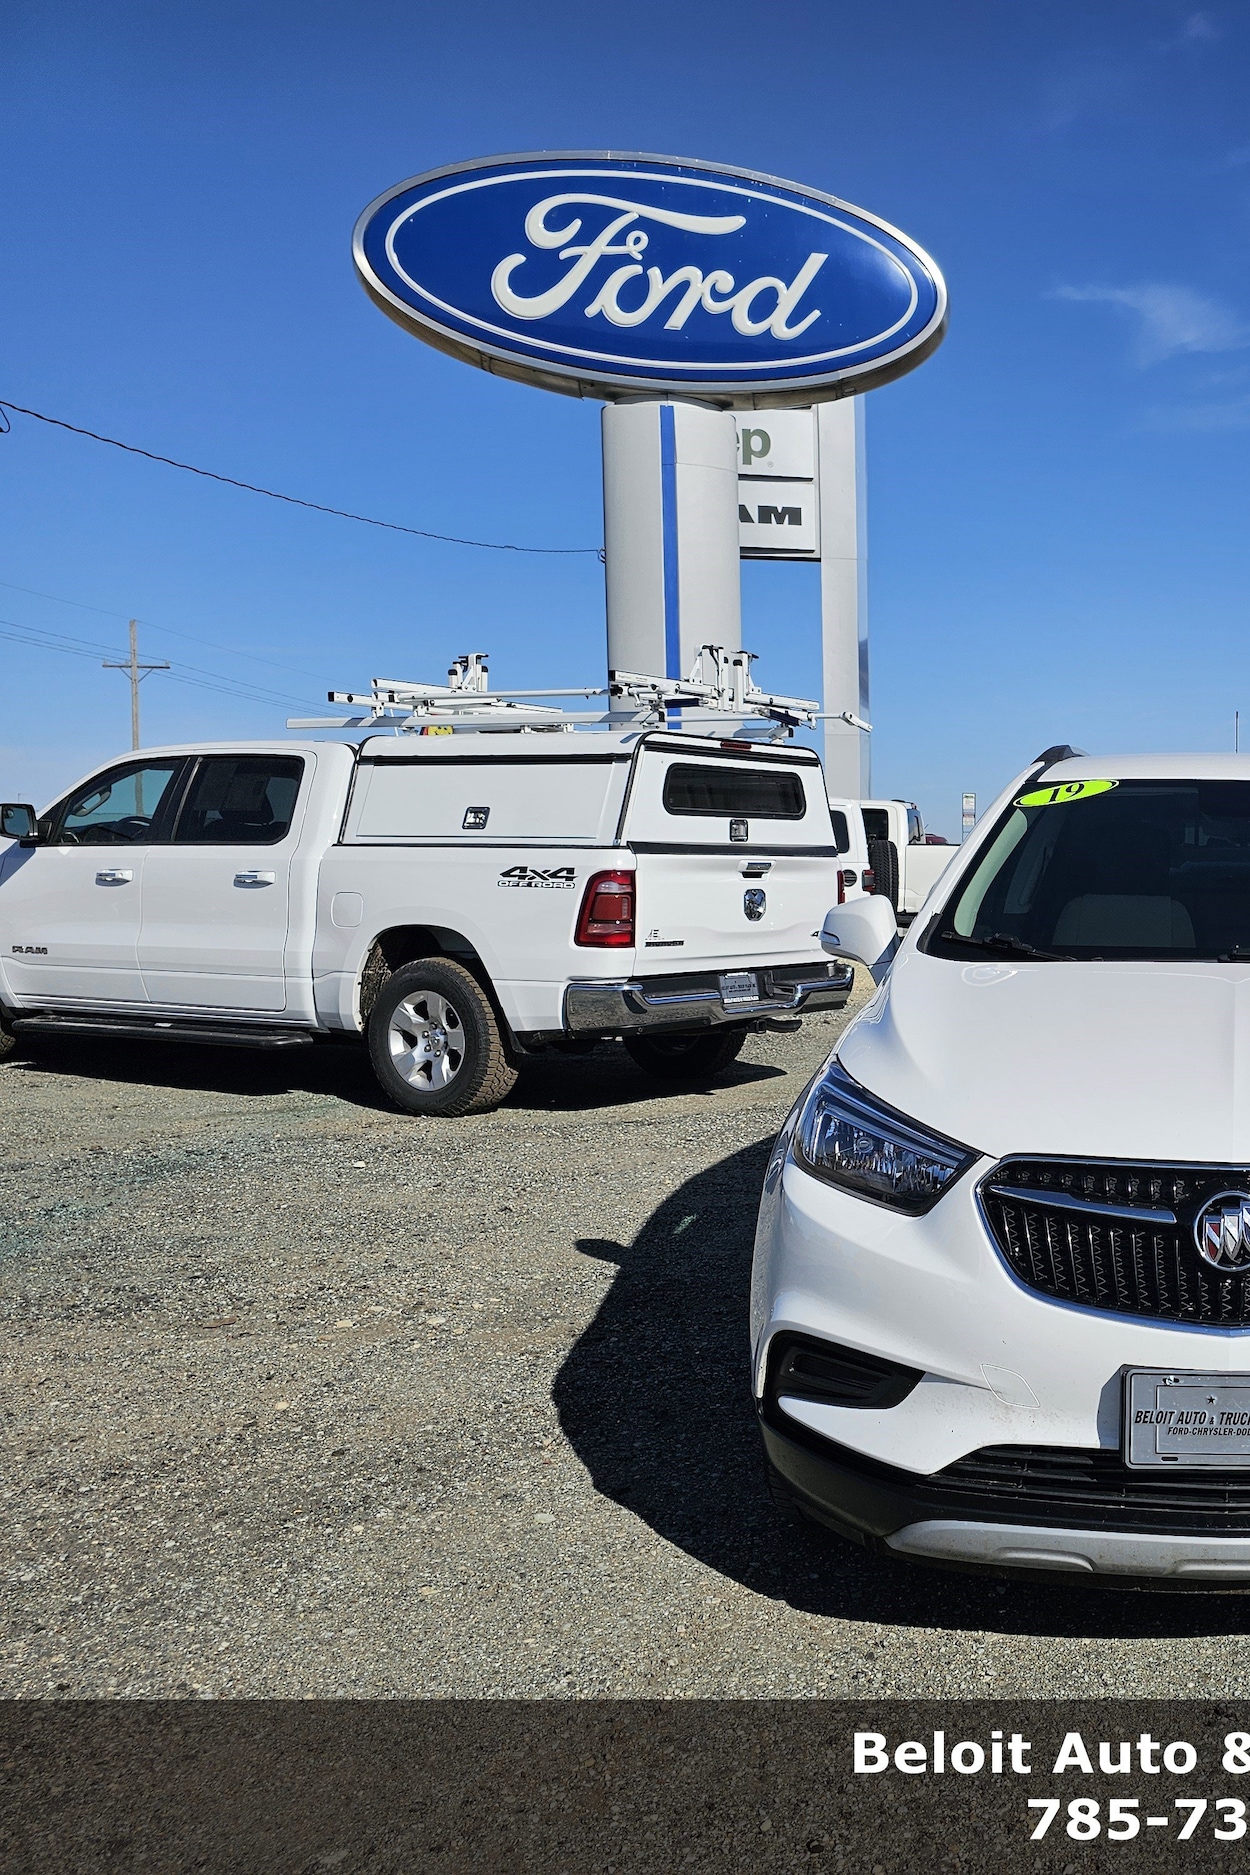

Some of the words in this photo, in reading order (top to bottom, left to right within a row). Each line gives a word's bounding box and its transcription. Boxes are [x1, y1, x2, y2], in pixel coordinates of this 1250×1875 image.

[491, 193, 828, 340] Ford
[1048, 782, 1085, 803] 19
[532, 881, 575, 889] ROAD
[12, 945, 48, 955] RAM
[1134, 1410, 1173, 1425] BELOIT
[1176, 1410, 1207, 1426] AUTO
[1209, 1416, 1215, 1425] &
